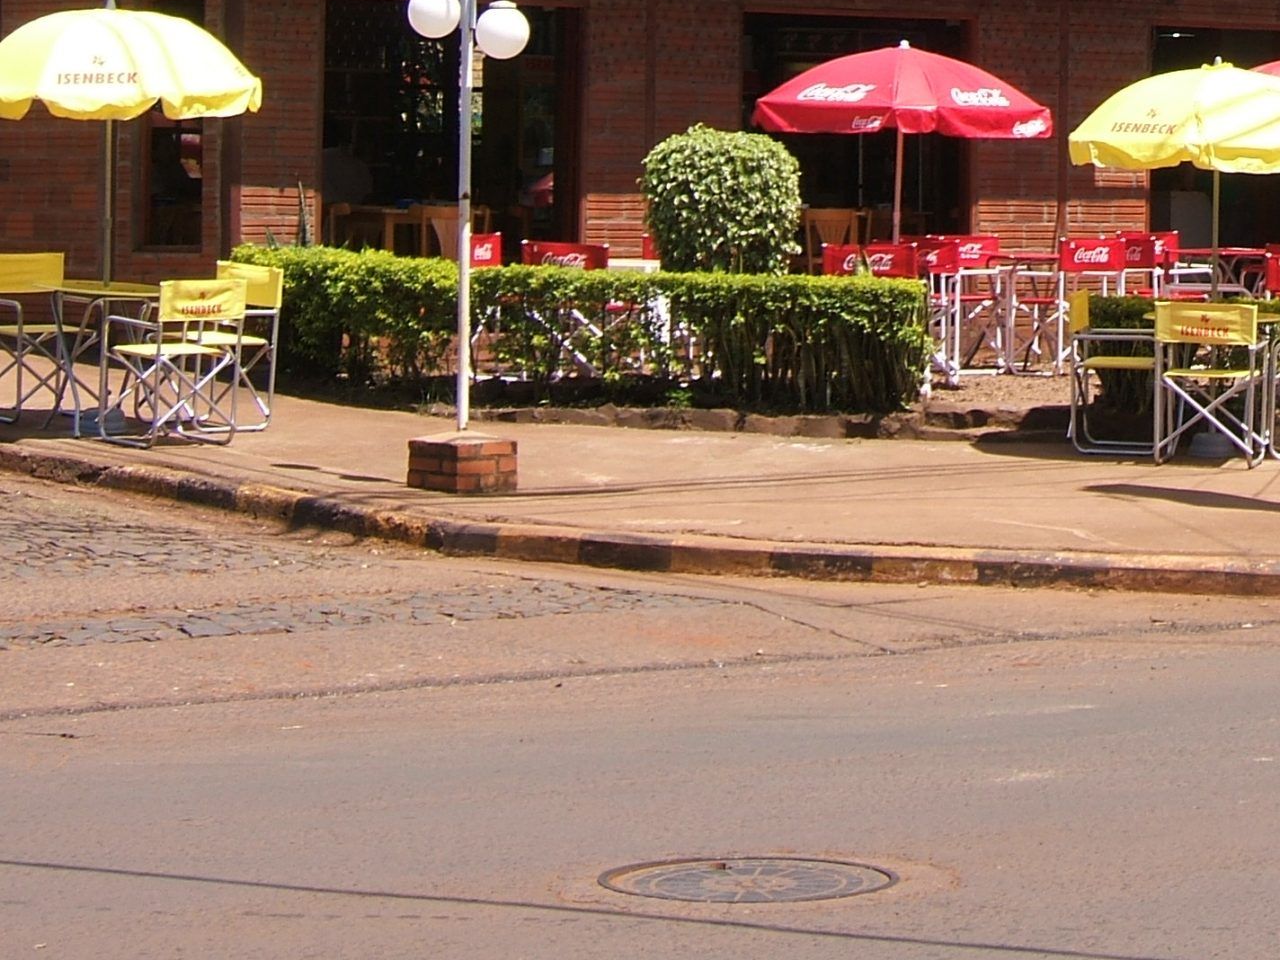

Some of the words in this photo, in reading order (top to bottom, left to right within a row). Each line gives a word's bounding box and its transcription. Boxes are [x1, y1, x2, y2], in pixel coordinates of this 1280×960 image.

[57, 71, 139, 85] ISENBECK
[1110, 122, 1178, 135] ISENBECK
[181, 304, 223, 316] ISENBECK
